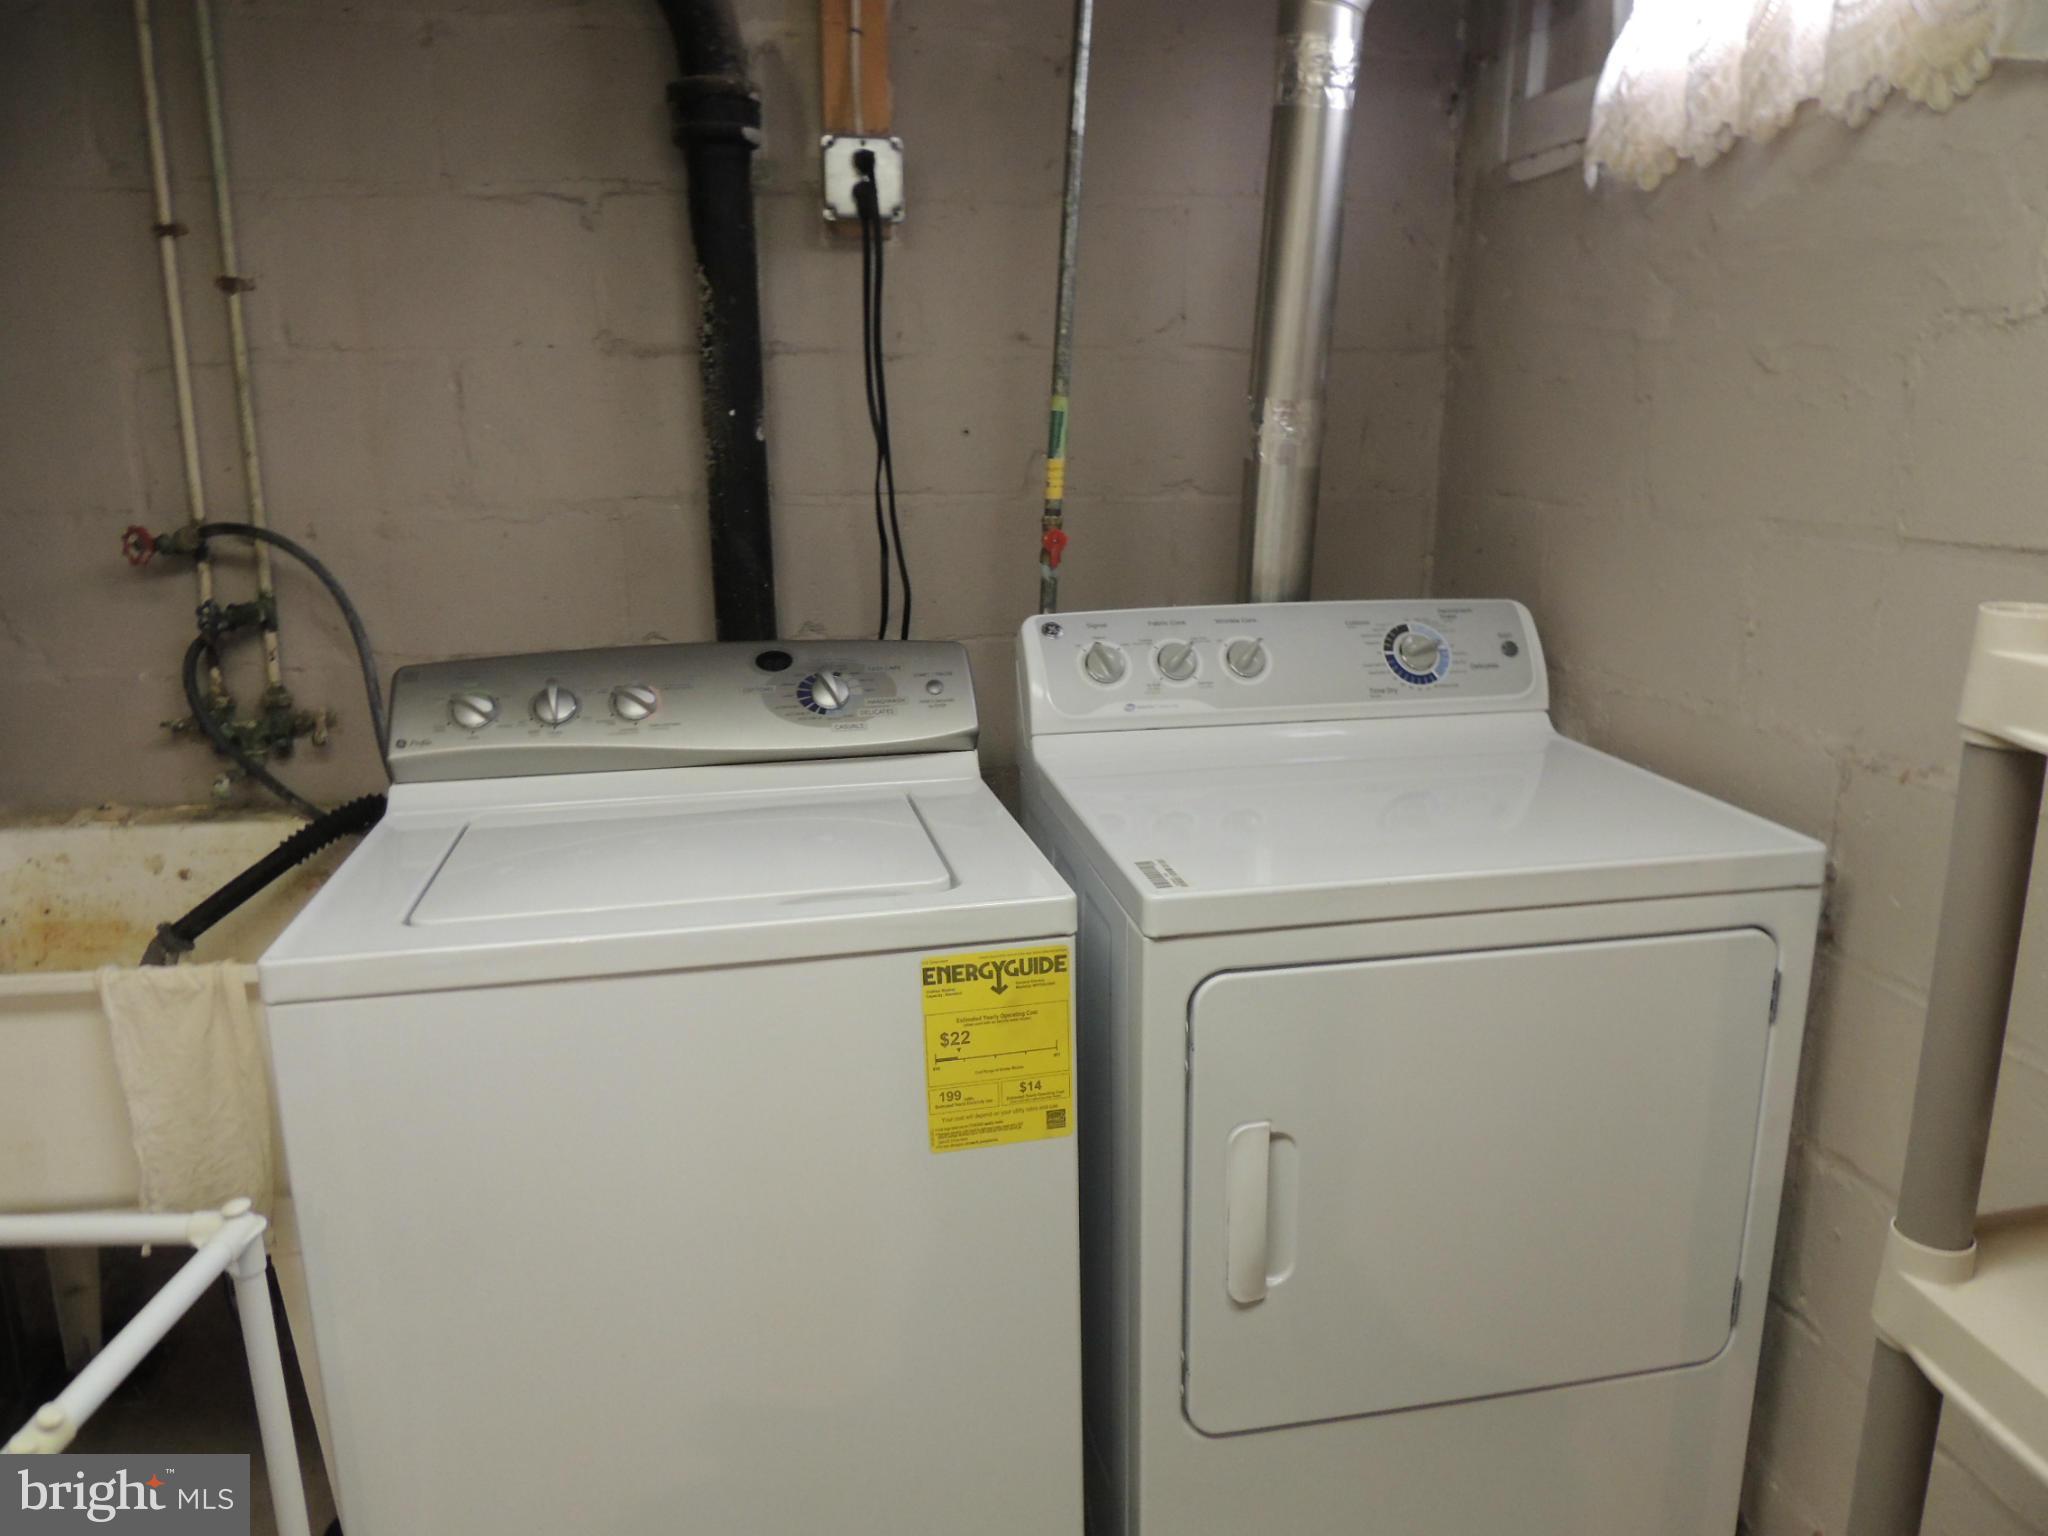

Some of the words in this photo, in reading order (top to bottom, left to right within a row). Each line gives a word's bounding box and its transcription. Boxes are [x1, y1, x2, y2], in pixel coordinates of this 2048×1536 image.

[922, 954, 1068, 986] ENERGYGUIDE
[939, 1030, 971, 1048] $22
[1019, 1080, 1042, 1093] $14
[939, 1090, 962, 1102] 199
